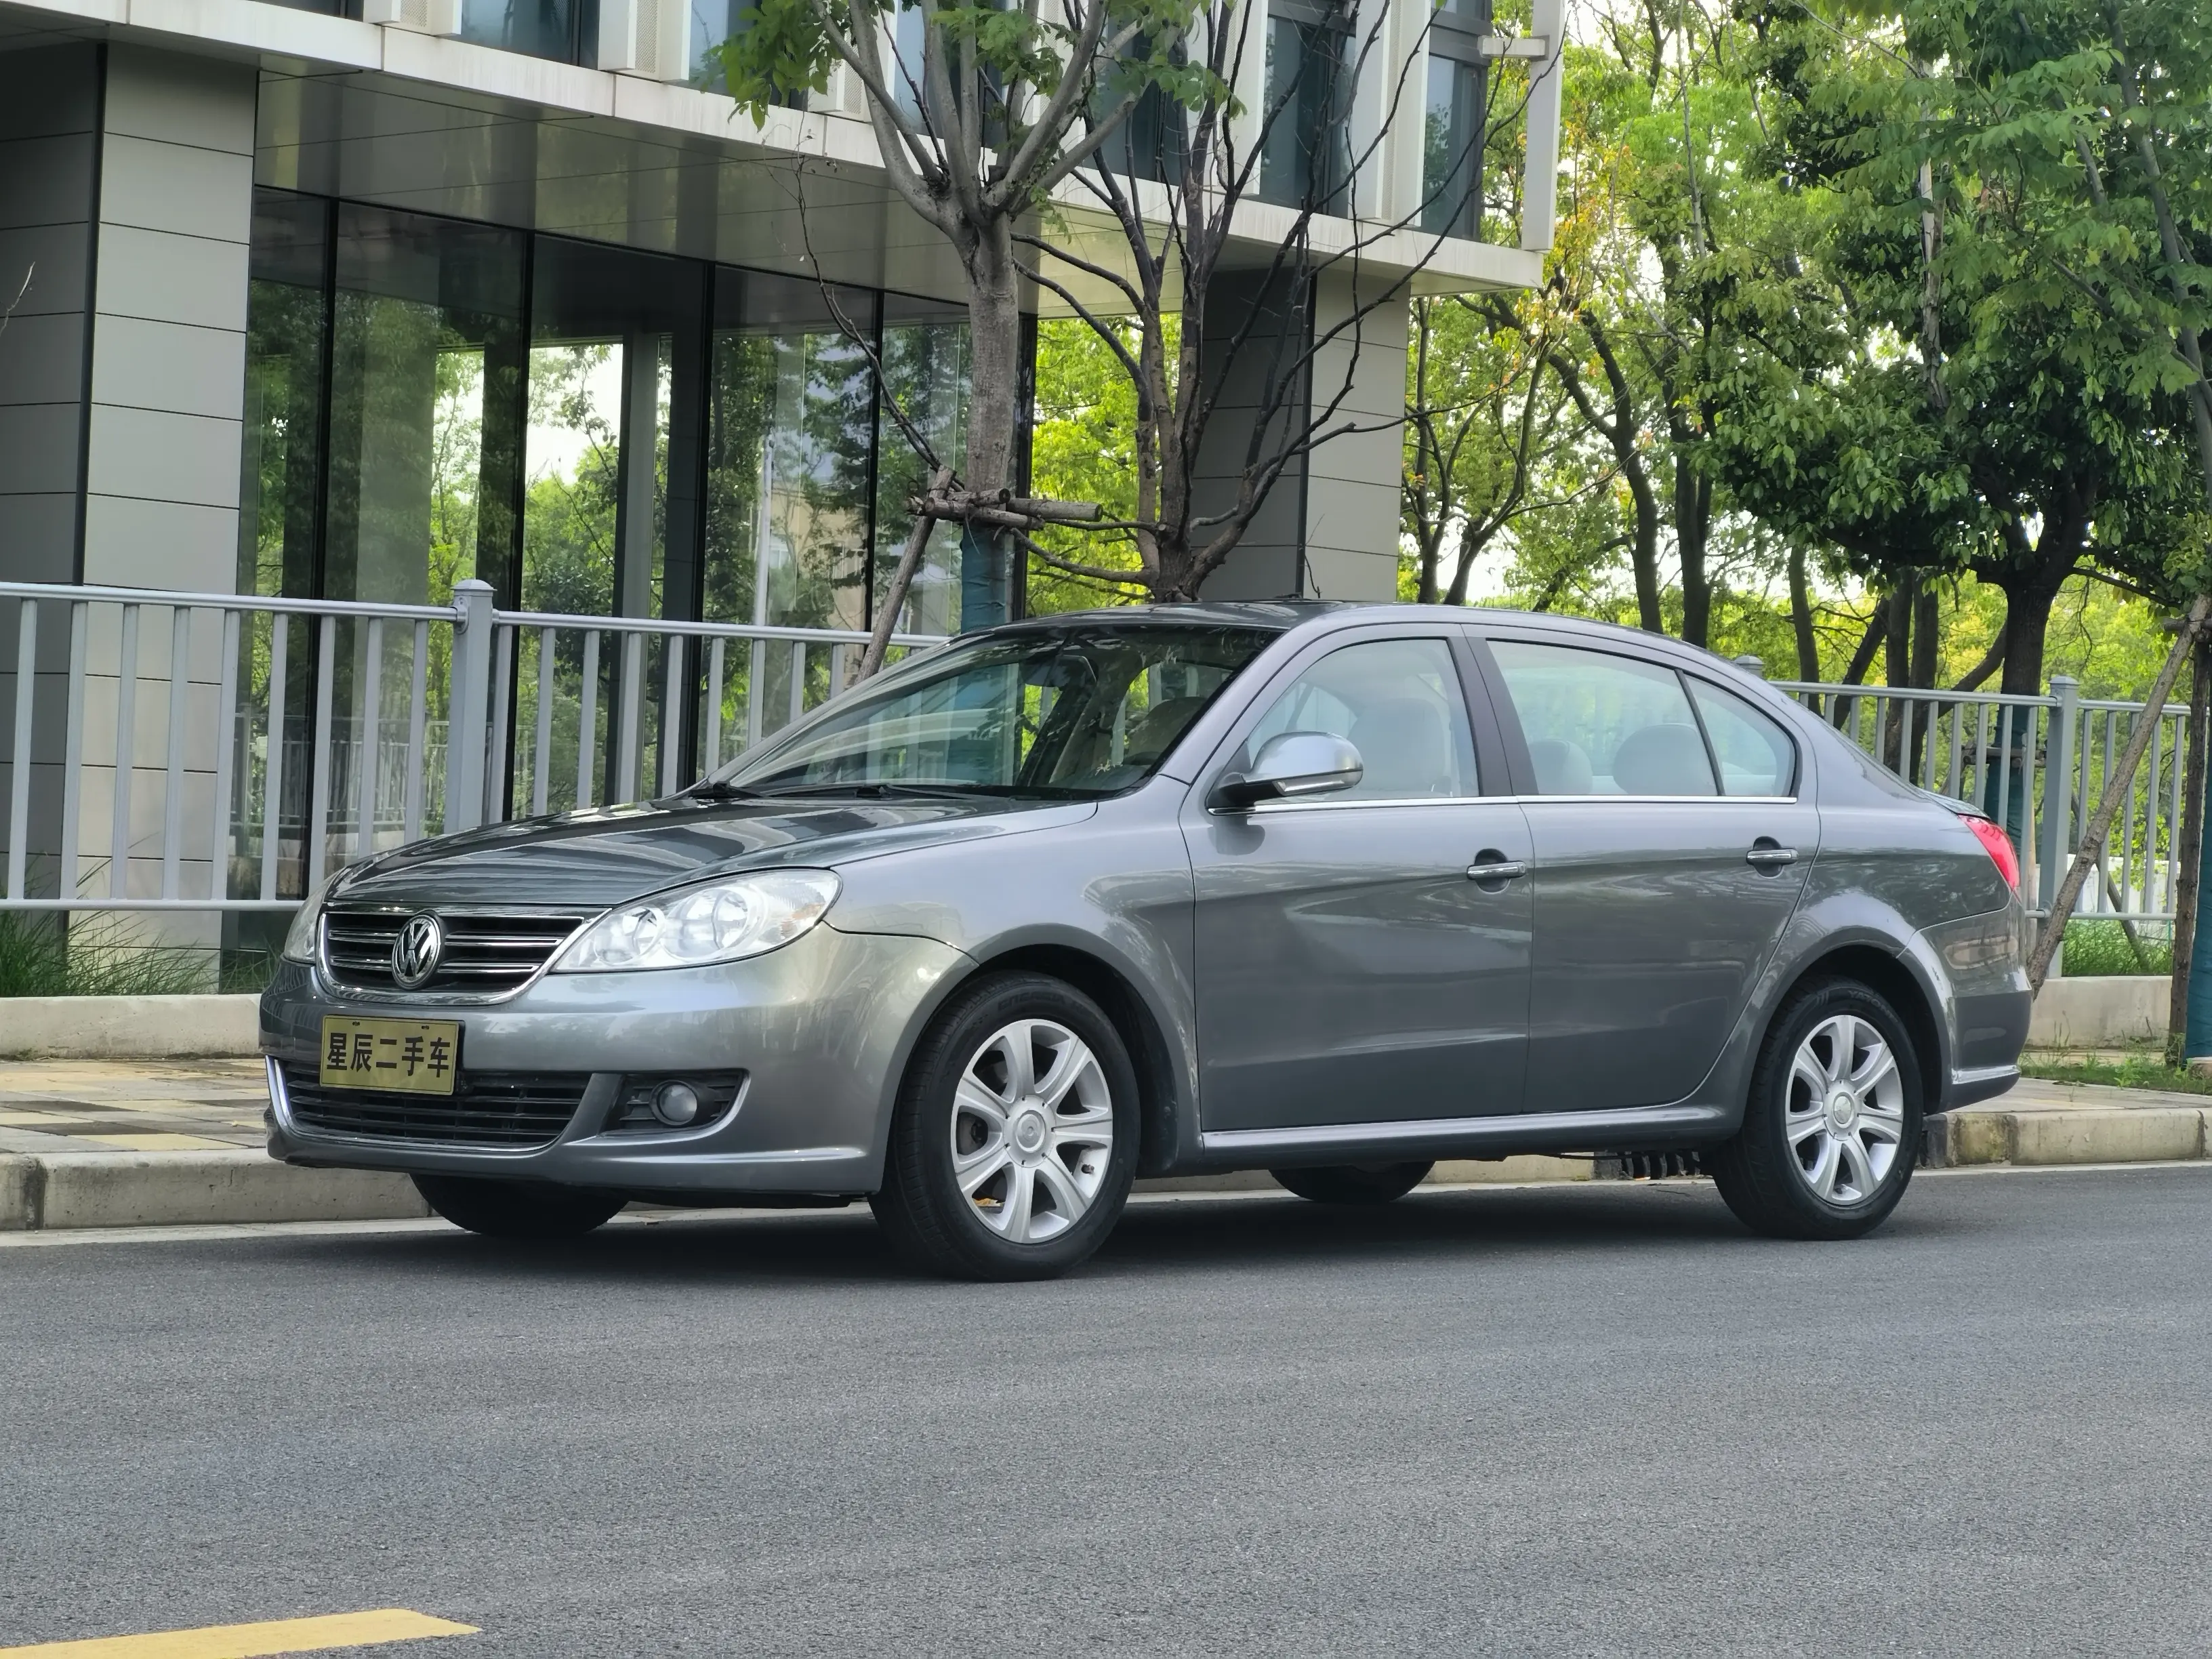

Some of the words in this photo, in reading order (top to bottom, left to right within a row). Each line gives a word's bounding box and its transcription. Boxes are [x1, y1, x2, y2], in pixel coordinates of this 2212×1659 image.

[395, 918, 439, 983] VW
[327, 1032, 451, 1078] 星辰二手车
